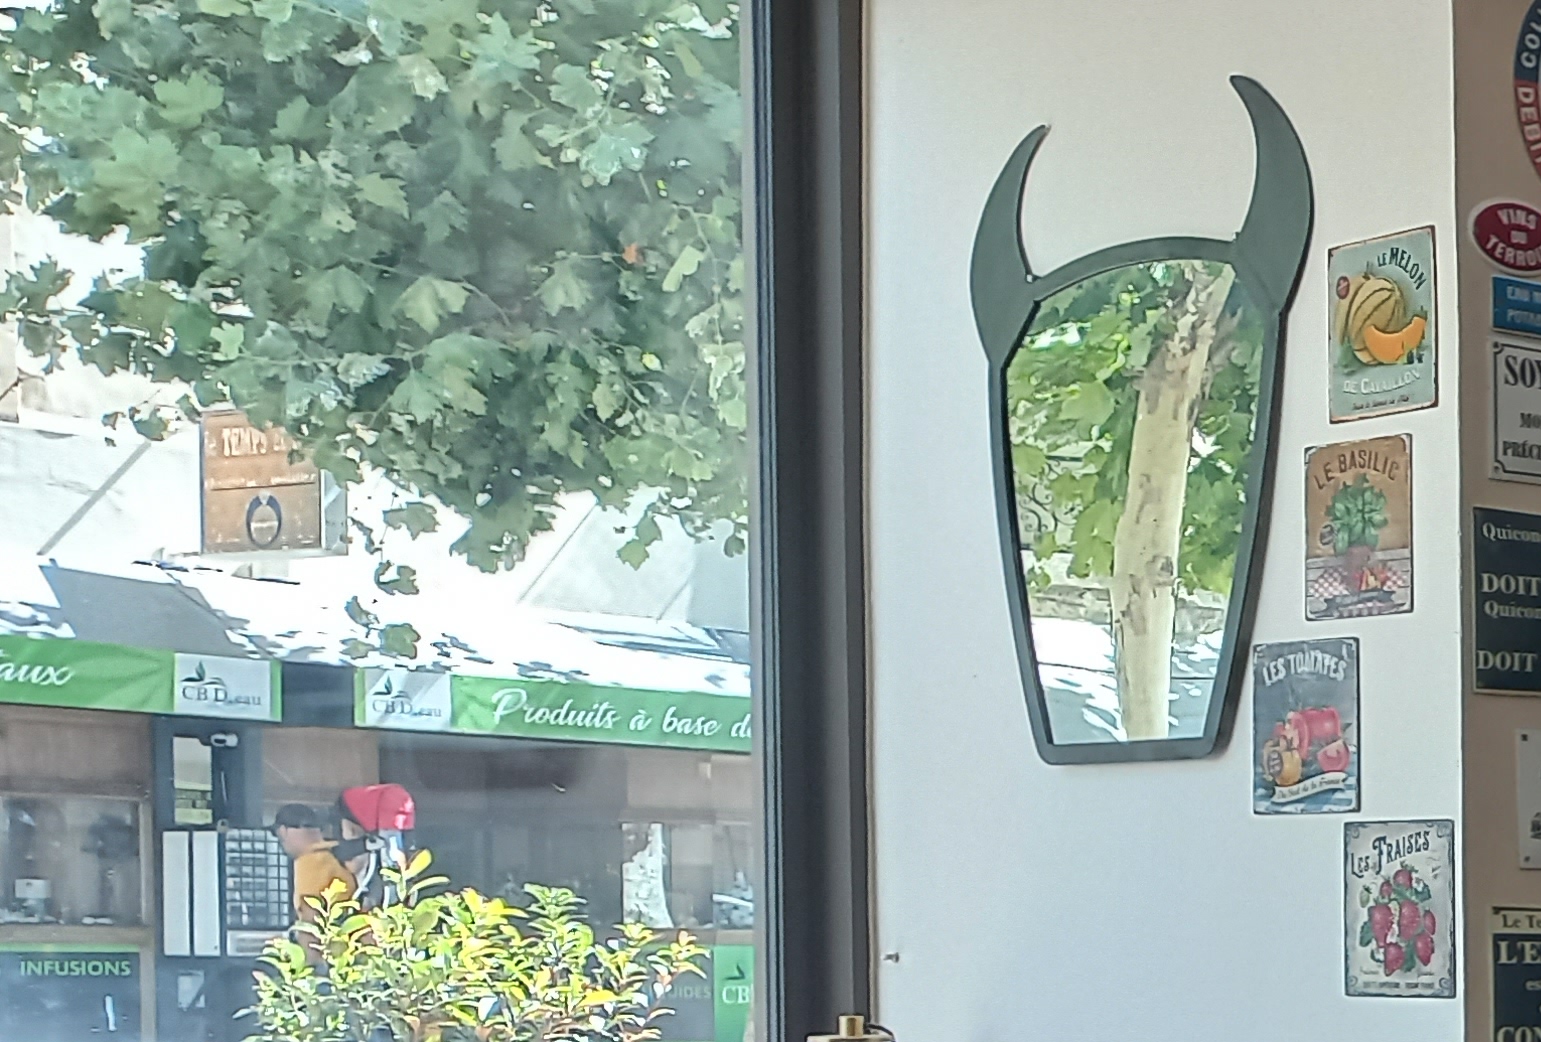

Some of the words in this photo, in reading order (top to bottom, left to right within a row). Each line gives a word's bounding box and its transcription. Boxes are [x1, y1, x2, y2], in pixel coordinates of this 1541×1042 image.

[1496, 208, 1538, 230] VINS
[1377, 252, 1388, 268] LE
[1388, 247, 1428, 290] MELON
[1313, 461, 1336, 490] LE
[1337, 449, 1400, 481] BASILIC
[0, 660, 75, 686] aux
[1262, 656, 1287, 687] LES
[1287, 650, 1348, 682] TOMATES
[1476, 650, 1539, 673] DOIT
[491, 687, 621, 731] Produits
[628, 708, 653, 732] à
[662, 705, 721, 739] base
[1501, 914, 1522, 929] Le
[20, 960, 131, 977] INFUSIONS
